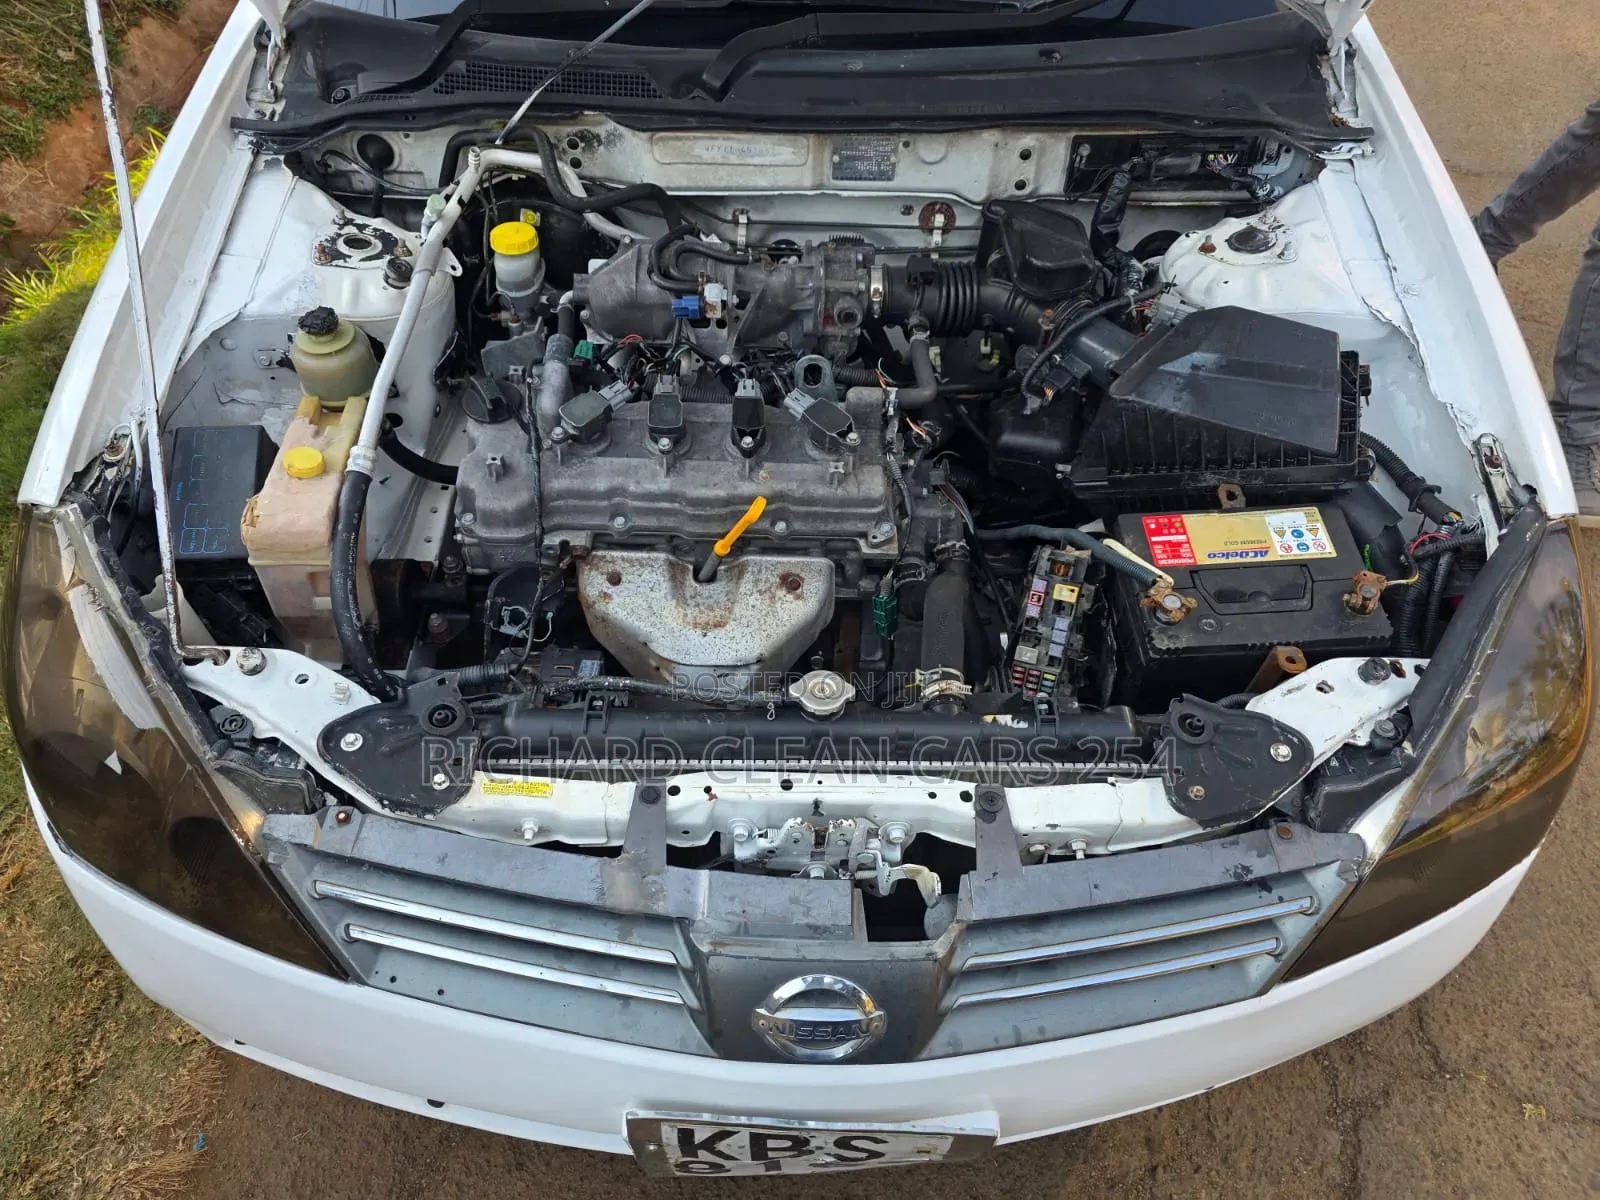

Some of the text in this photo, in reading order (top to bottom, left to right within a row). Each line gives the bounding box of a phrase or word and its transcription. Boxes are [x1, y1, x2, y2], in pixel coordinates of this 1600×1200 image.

[1207, 550, 1269, 559] ACDelco
[767, 1021, 871, 1041] NISSAN
[677, 1127, 889, 1162] KBS
